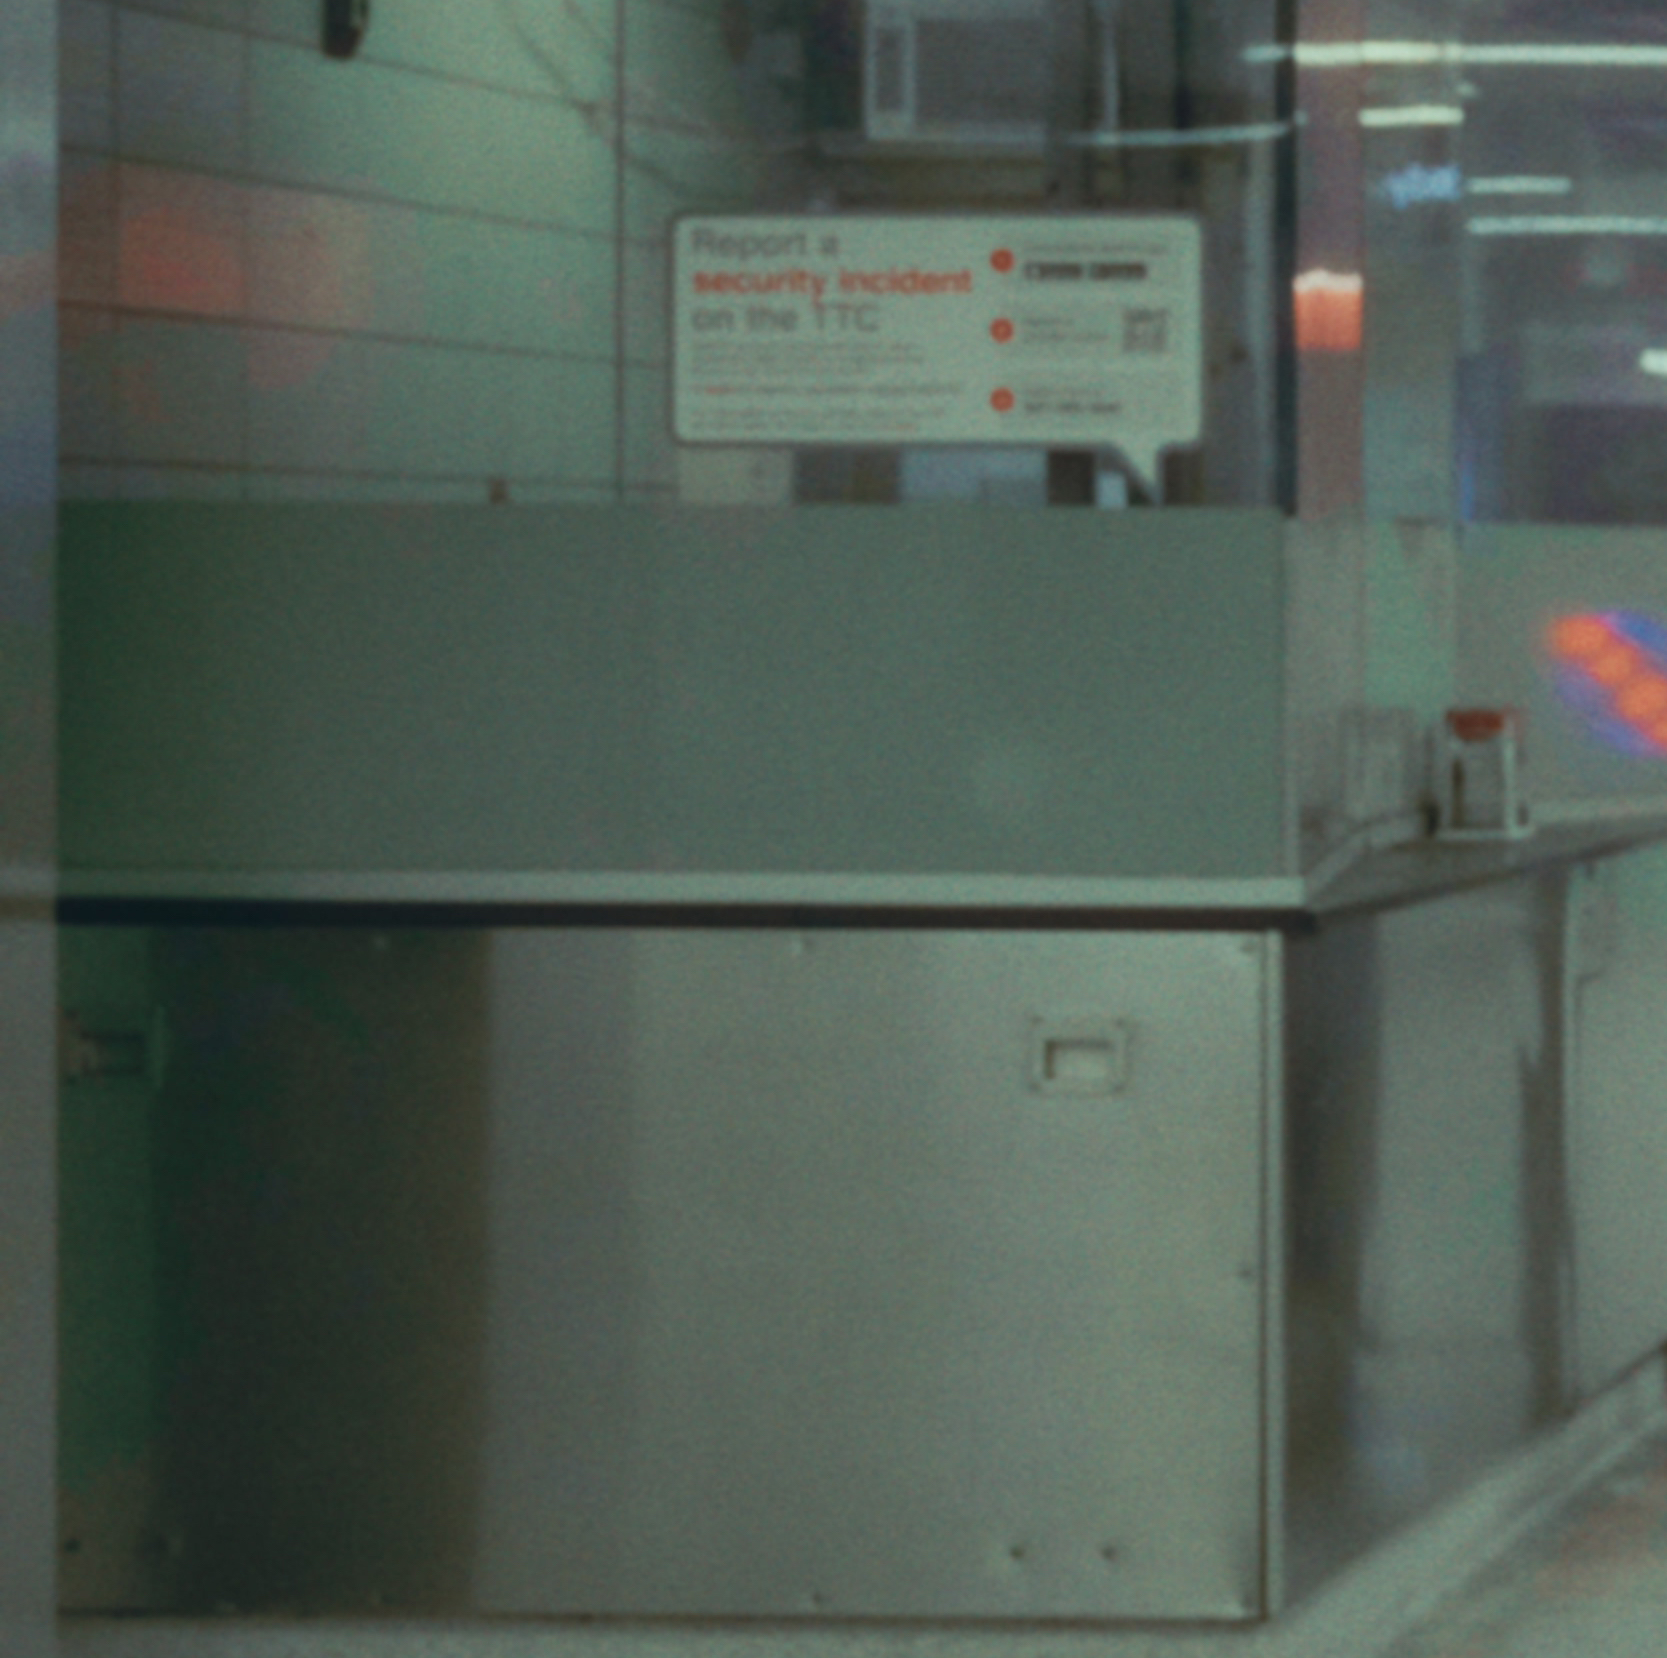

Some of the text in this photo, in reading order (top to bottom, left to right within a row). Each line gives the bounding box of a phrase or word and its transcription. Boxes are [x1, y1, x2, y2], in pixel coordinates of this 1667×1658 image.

[690, 228, 840, 260] Report a
[692, 266, 973, 300] security incident
[691, 302, 880, 333] on the TTC
